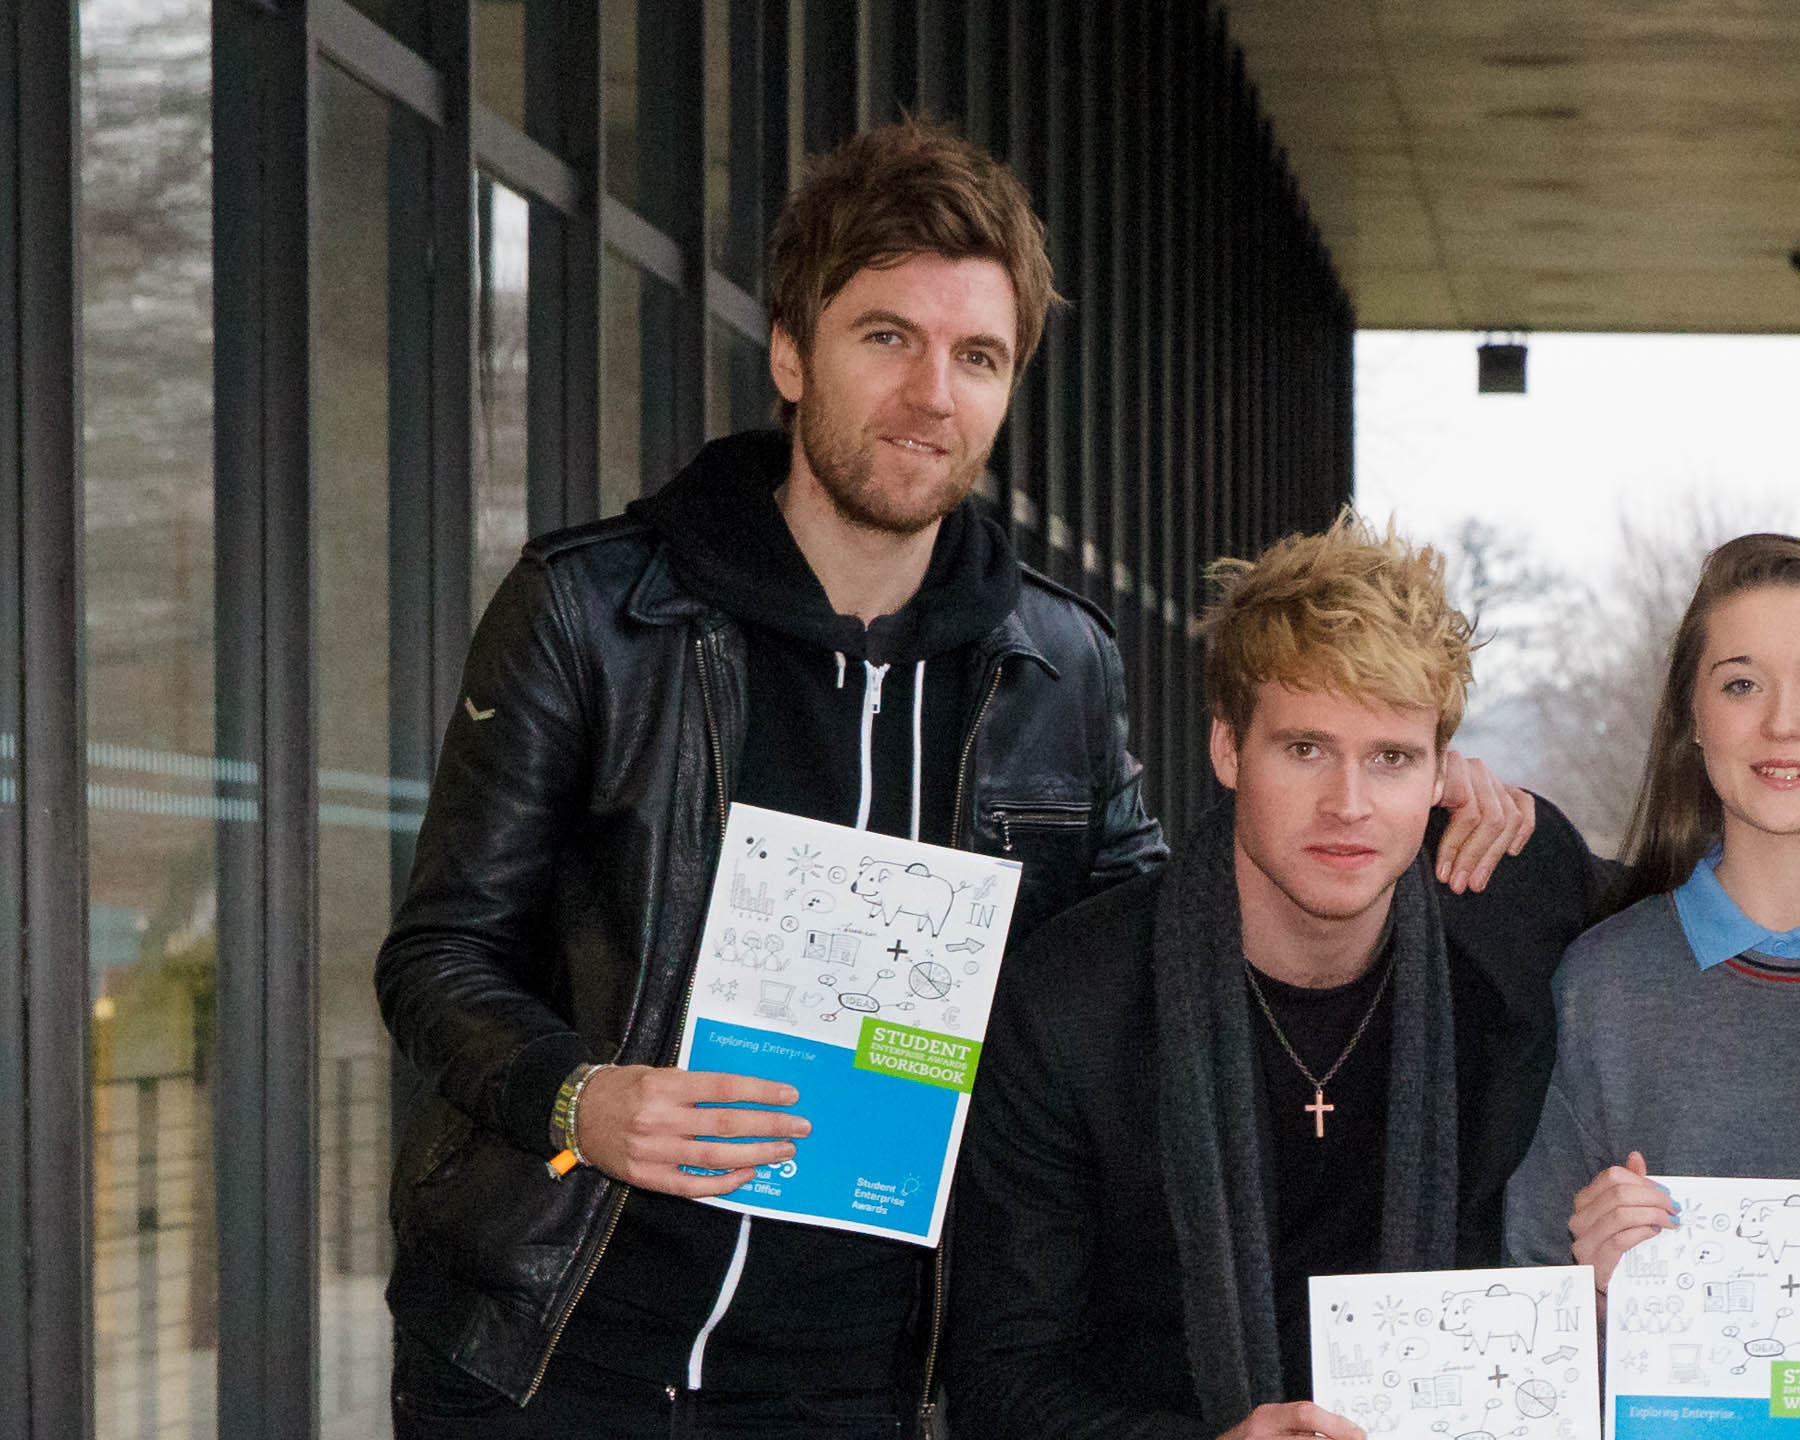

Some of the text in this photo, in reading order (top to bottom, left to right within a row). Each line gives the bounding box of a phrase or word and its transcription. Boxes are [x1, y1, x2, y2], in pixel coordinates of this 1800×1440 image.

[845, 996, 876, 1010] IDEAS
[708, 1031, 759, 1053] Exploring
[873, 1027, 971, 1060] STUDENT
[871, 1042, 968, 1070] ENTERPRISE AWARDS
[869, 1052, 966, 1084] WORKBOOK
[754, 1183, 781, 1196] Office
[857, 1177, 896, 1192] Student
[855, 1188, 904, 1207] Enterprise
[852, 1200, 888, 1215] Awards
[1630, 1406, 1679, 1421] Exploring
